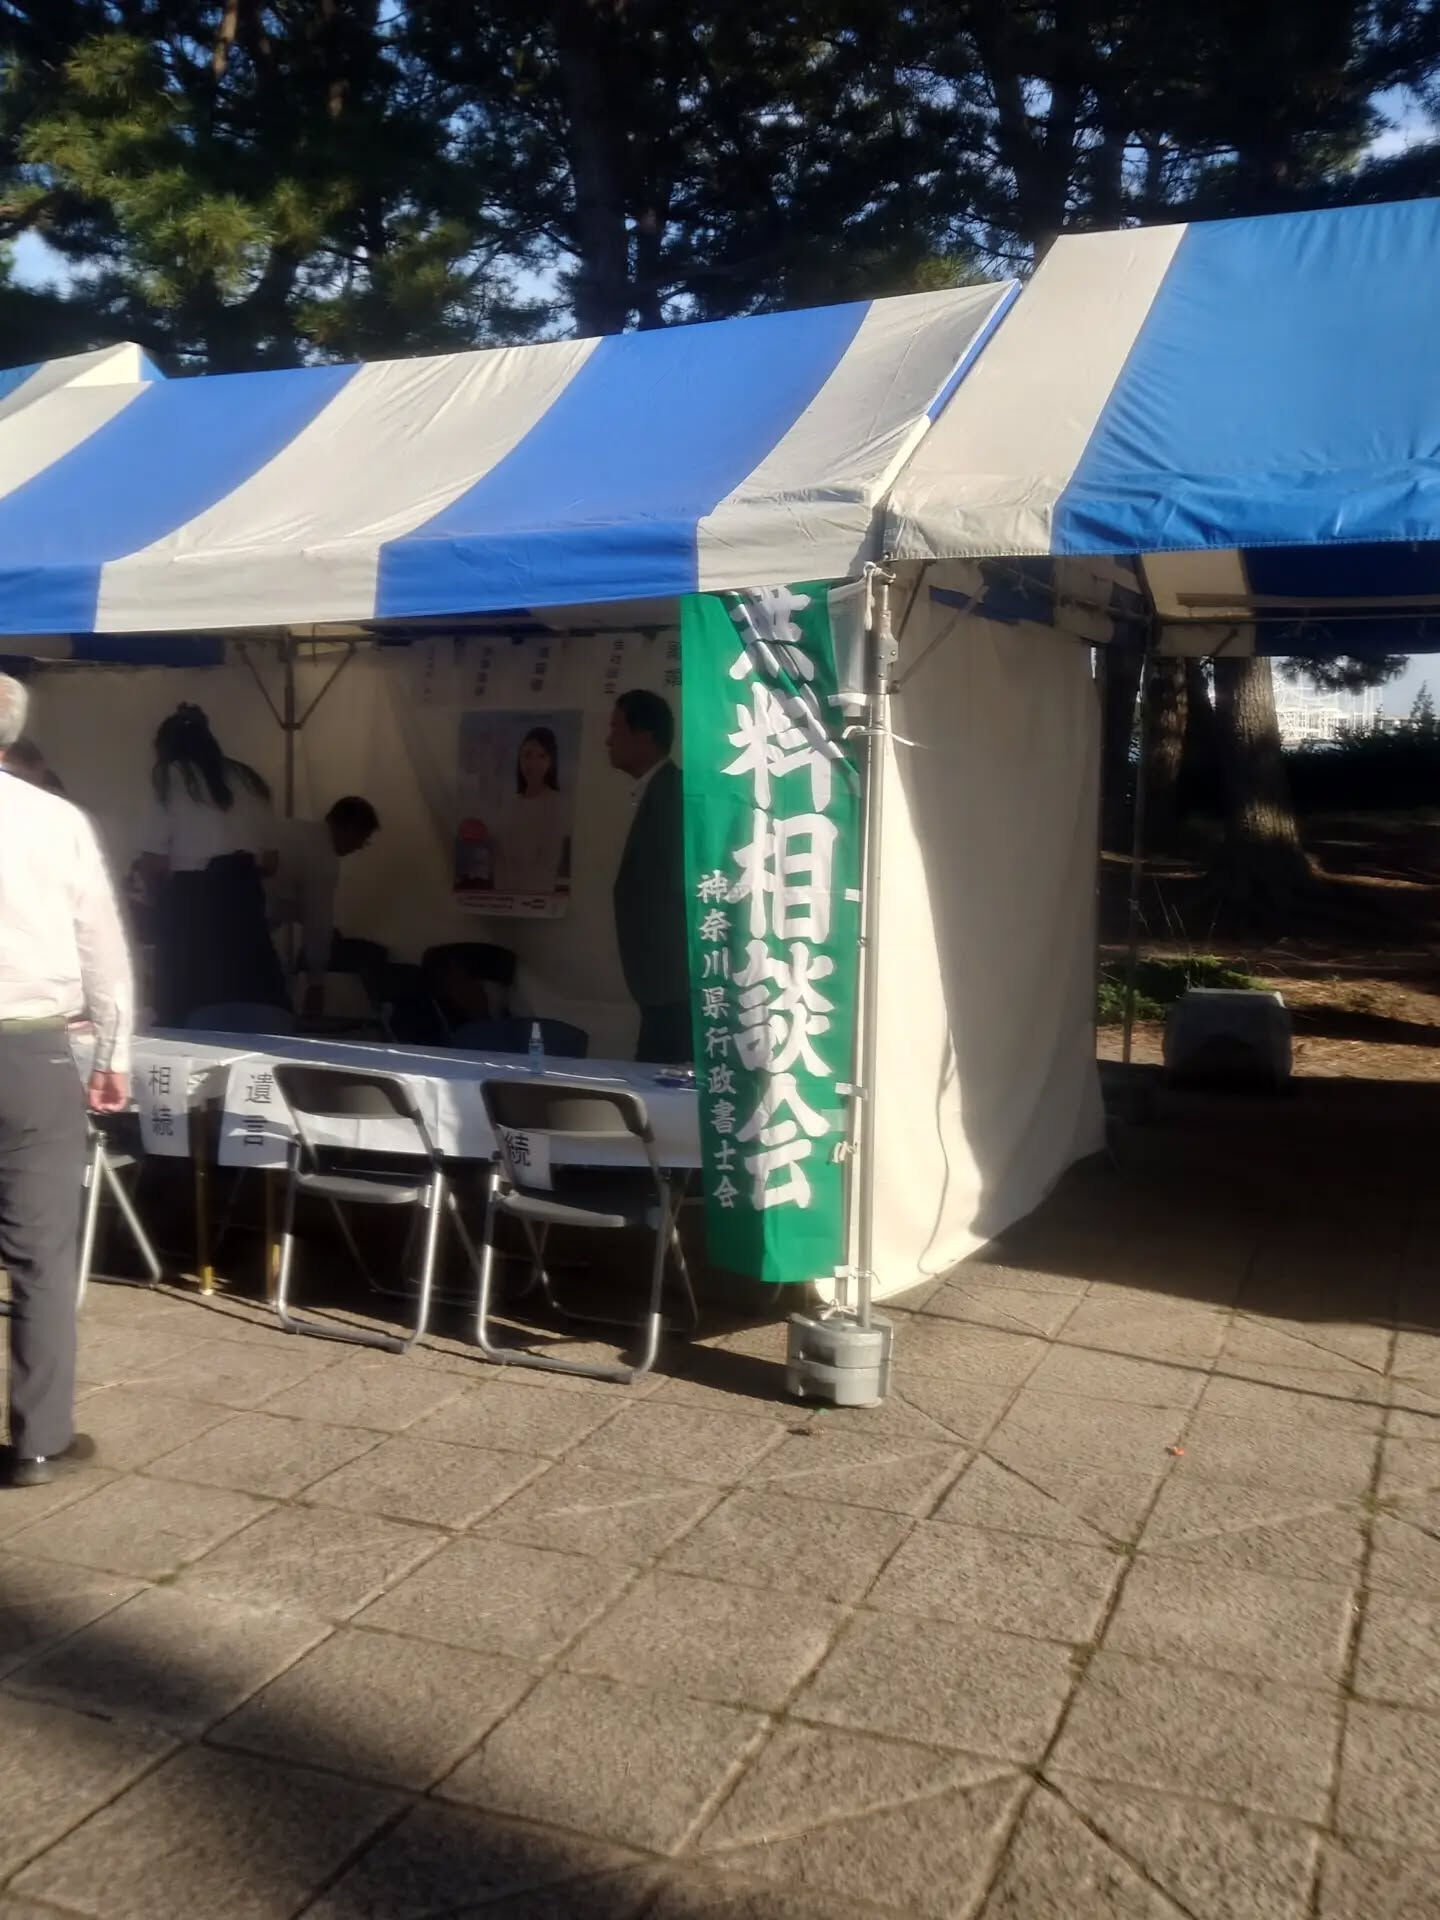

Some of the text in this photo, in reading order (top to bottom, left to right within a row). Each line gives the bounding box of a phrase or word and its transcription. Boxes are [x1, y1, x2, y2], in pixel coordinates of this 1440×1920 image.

[696, 869, 740, 1209] 神奈川県行政書士会
[148, 1065, 173, 1136] 相続
[243, 1072, 274, 1148] 遺言
